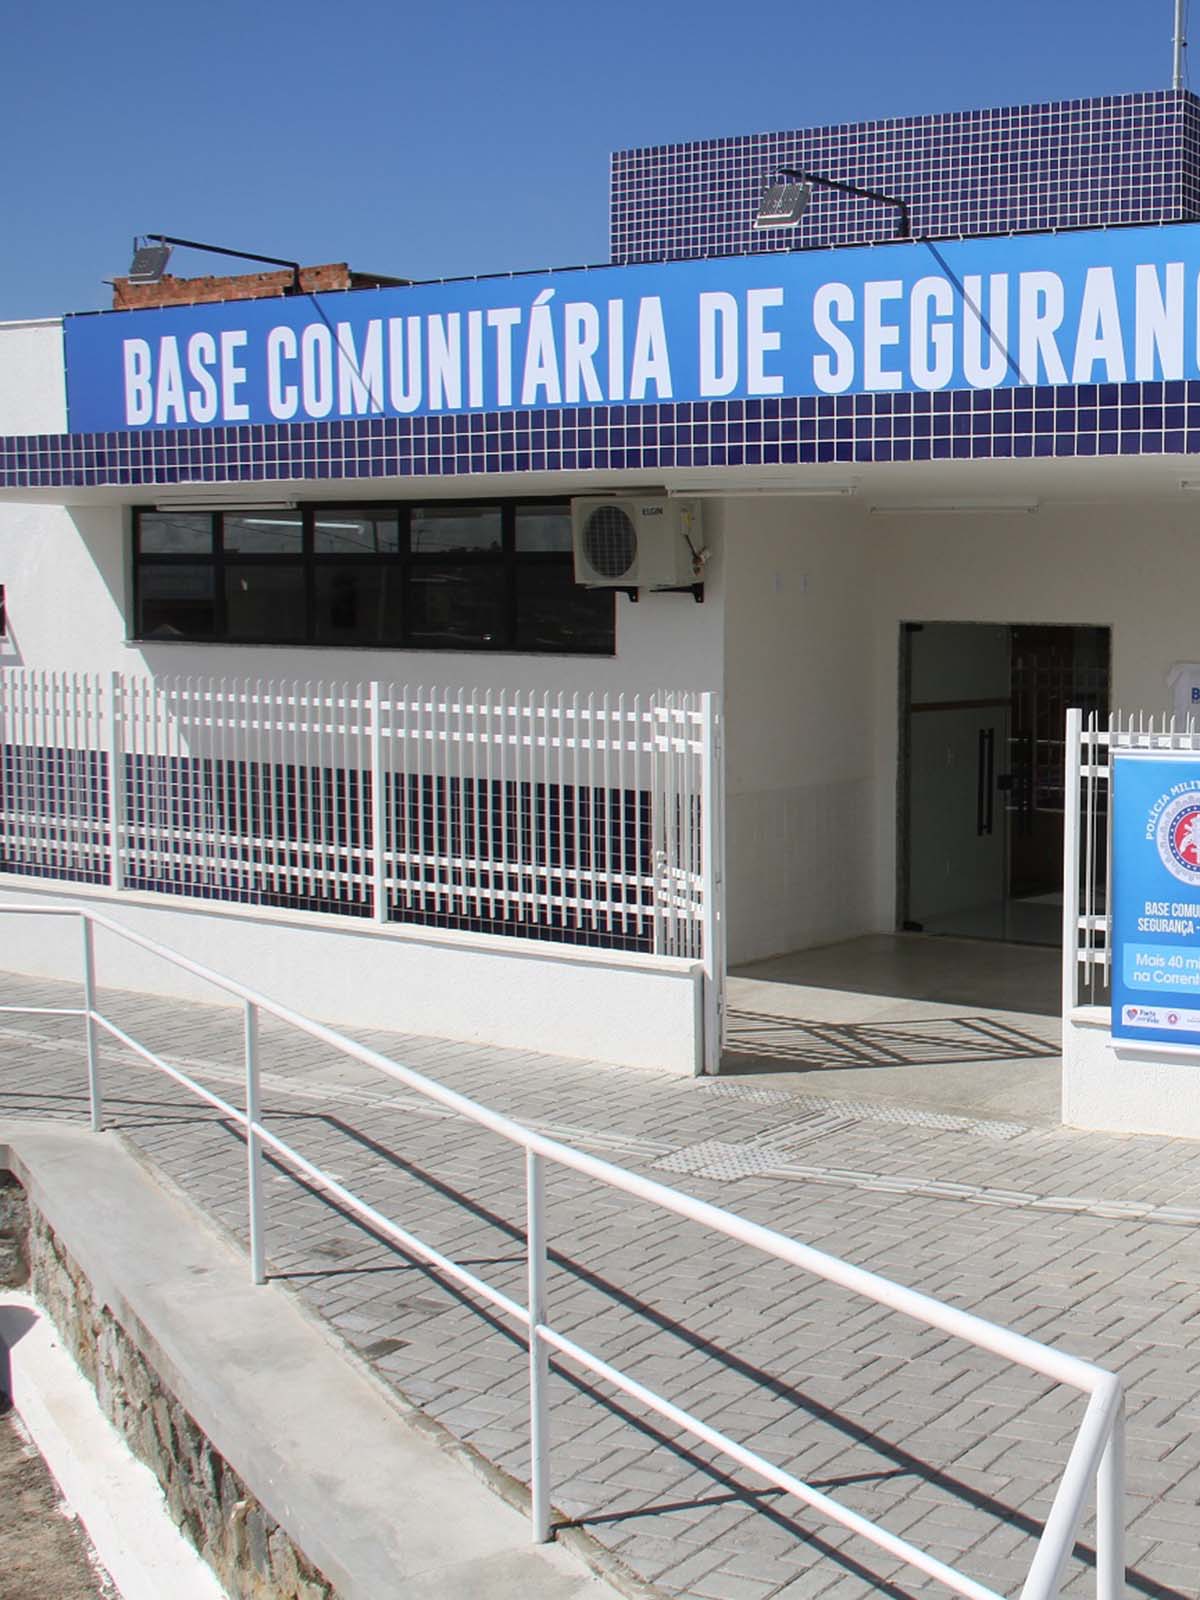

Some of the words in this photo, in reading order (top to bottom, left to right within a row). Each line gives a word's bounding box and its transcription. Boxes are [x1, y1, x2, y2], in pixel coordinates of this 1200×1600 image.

[123, 330, 250, 427] BASE
[267, 288, 674, 420] COMUNITÁRIA
[699, 287, 784, 397] DE
[1145, 793, 1170, 841] POLÍCIA
[1144, 901, 1170, 917] BASE
[1137, 917, 1194, 937] SEGURANÇA
[1135, 953, 1166, 967] Mais
[1167, 955, 1184, 969] 40
[1133, 971, 1150, 982] na
